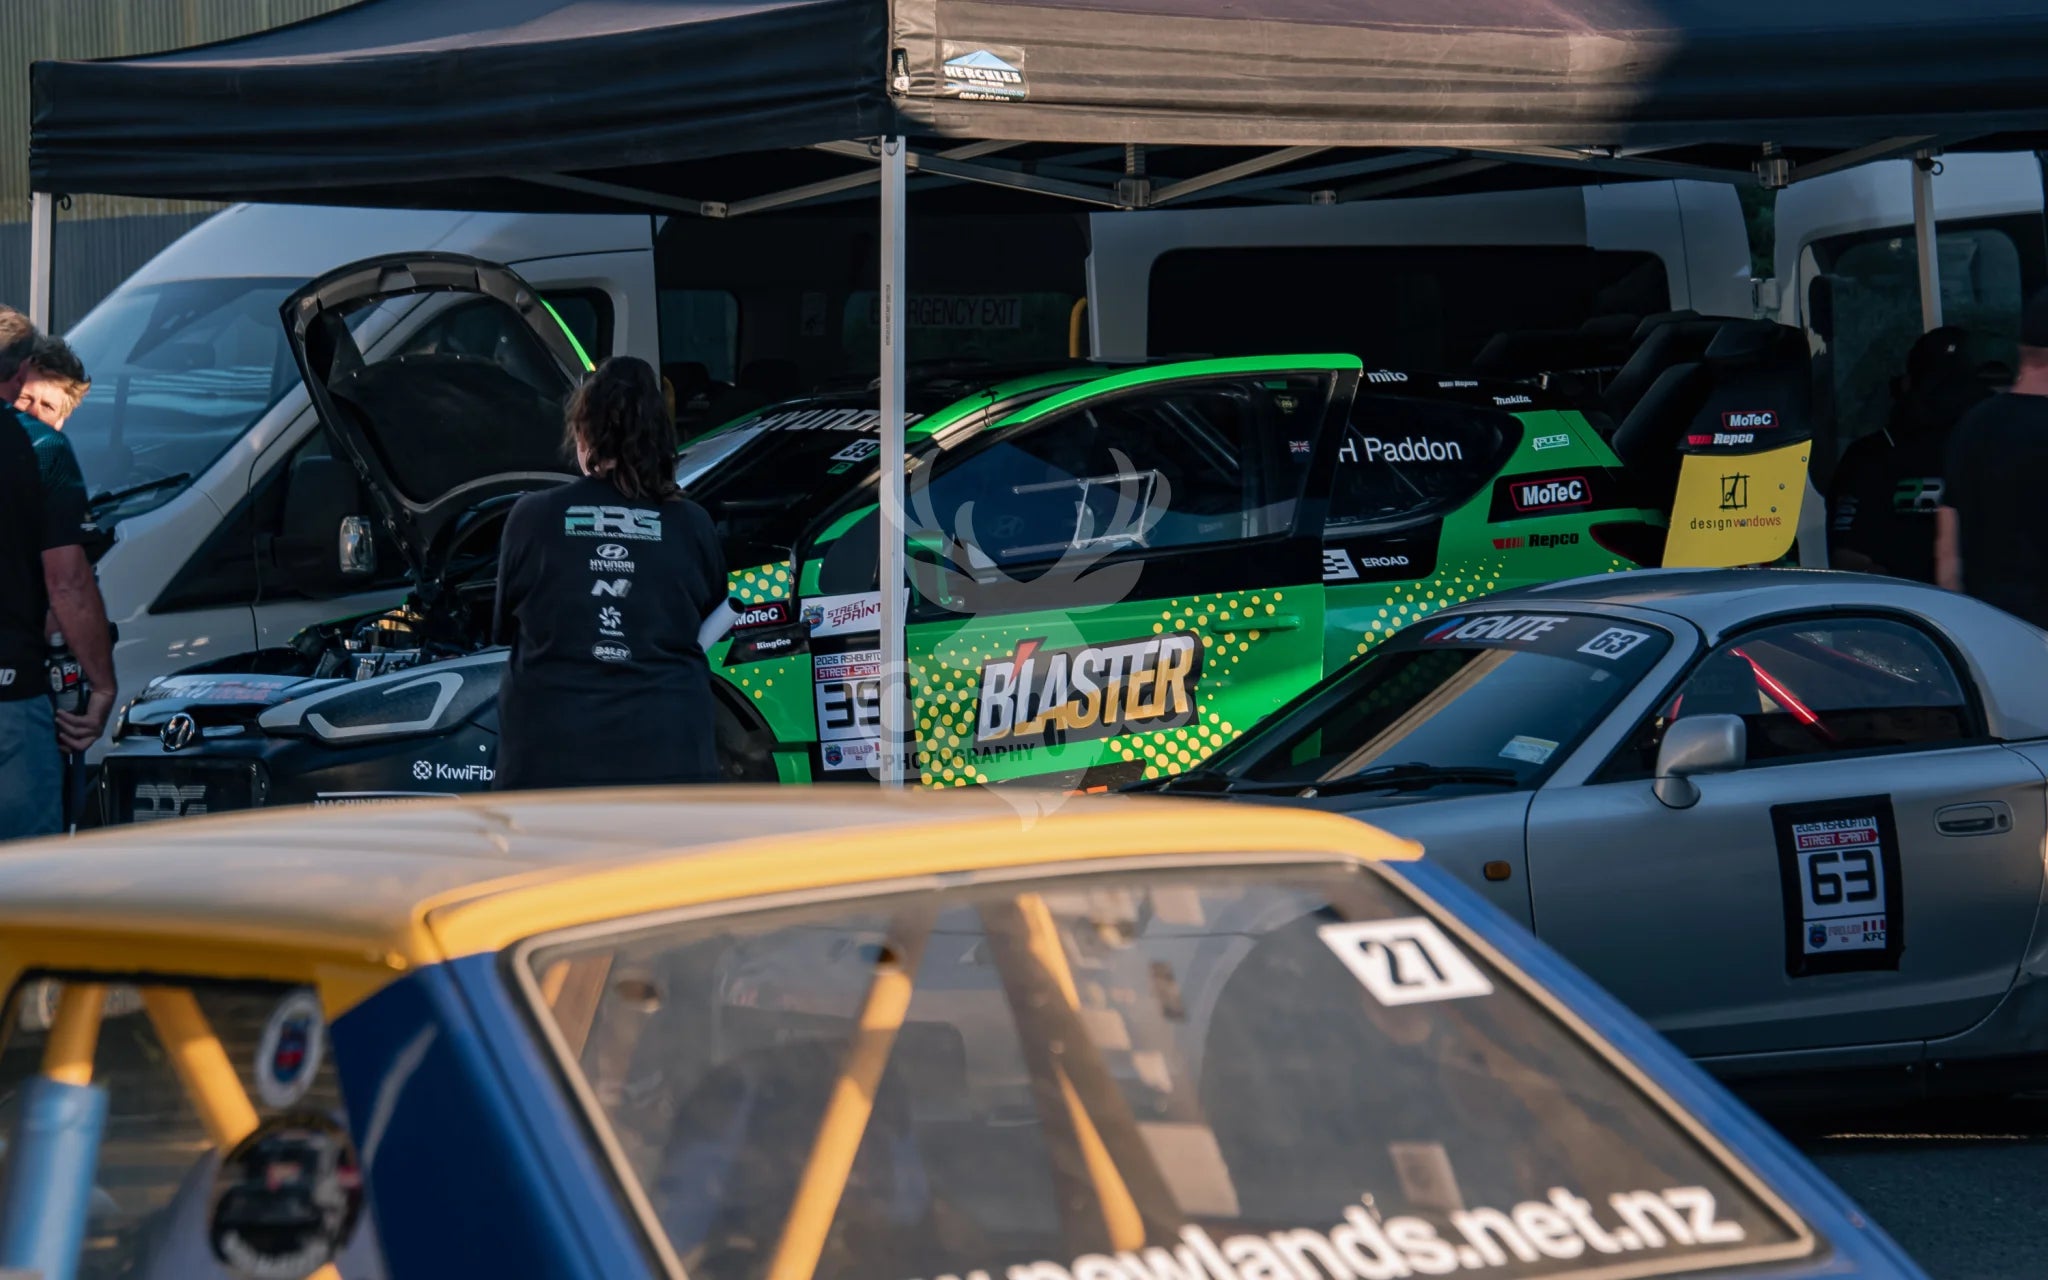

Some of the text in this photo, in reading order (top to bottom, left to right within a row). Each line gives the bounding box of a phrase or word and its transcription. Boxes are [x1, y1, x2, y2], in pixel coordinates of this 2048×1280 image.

[944, 65, 1022, 83] HERCULES
[869, 298, 977, 325] ERGENCY
[982, 298, 1019, 325] EXIT
[1729, 413, 1773, 427] MoTeC
[1713, 433, 1755, 446] Repco
[1364, 435, 1463, 463] Paddon
[1522, 480, 1583, 506] MoTeC
[1690, 515, 1782, 531] designwndows
[1528, 533, 1580, 548] Repco
[589, 559, 635, 569] HYUNDAI
[1361, 555, 1409, 568] EROAD
[735, 607, 779, 627] MoTeC
[826, 599, 866, 619] STREET
[756, 638, 792, 650] KingGee
[1588, 630, 1637, 654] 63
[815, 656, 840, 666] 2026
[819, 666, 851, 678] STREET
[976, 635, 1196, 743] BLASTER
[824, 681, 880, 729] 39
[1801, 831, 1872, 847] STREET SPRINT
[1808, 849, 1877, 906] 63
[1358, 936, 1446, 985] 27
